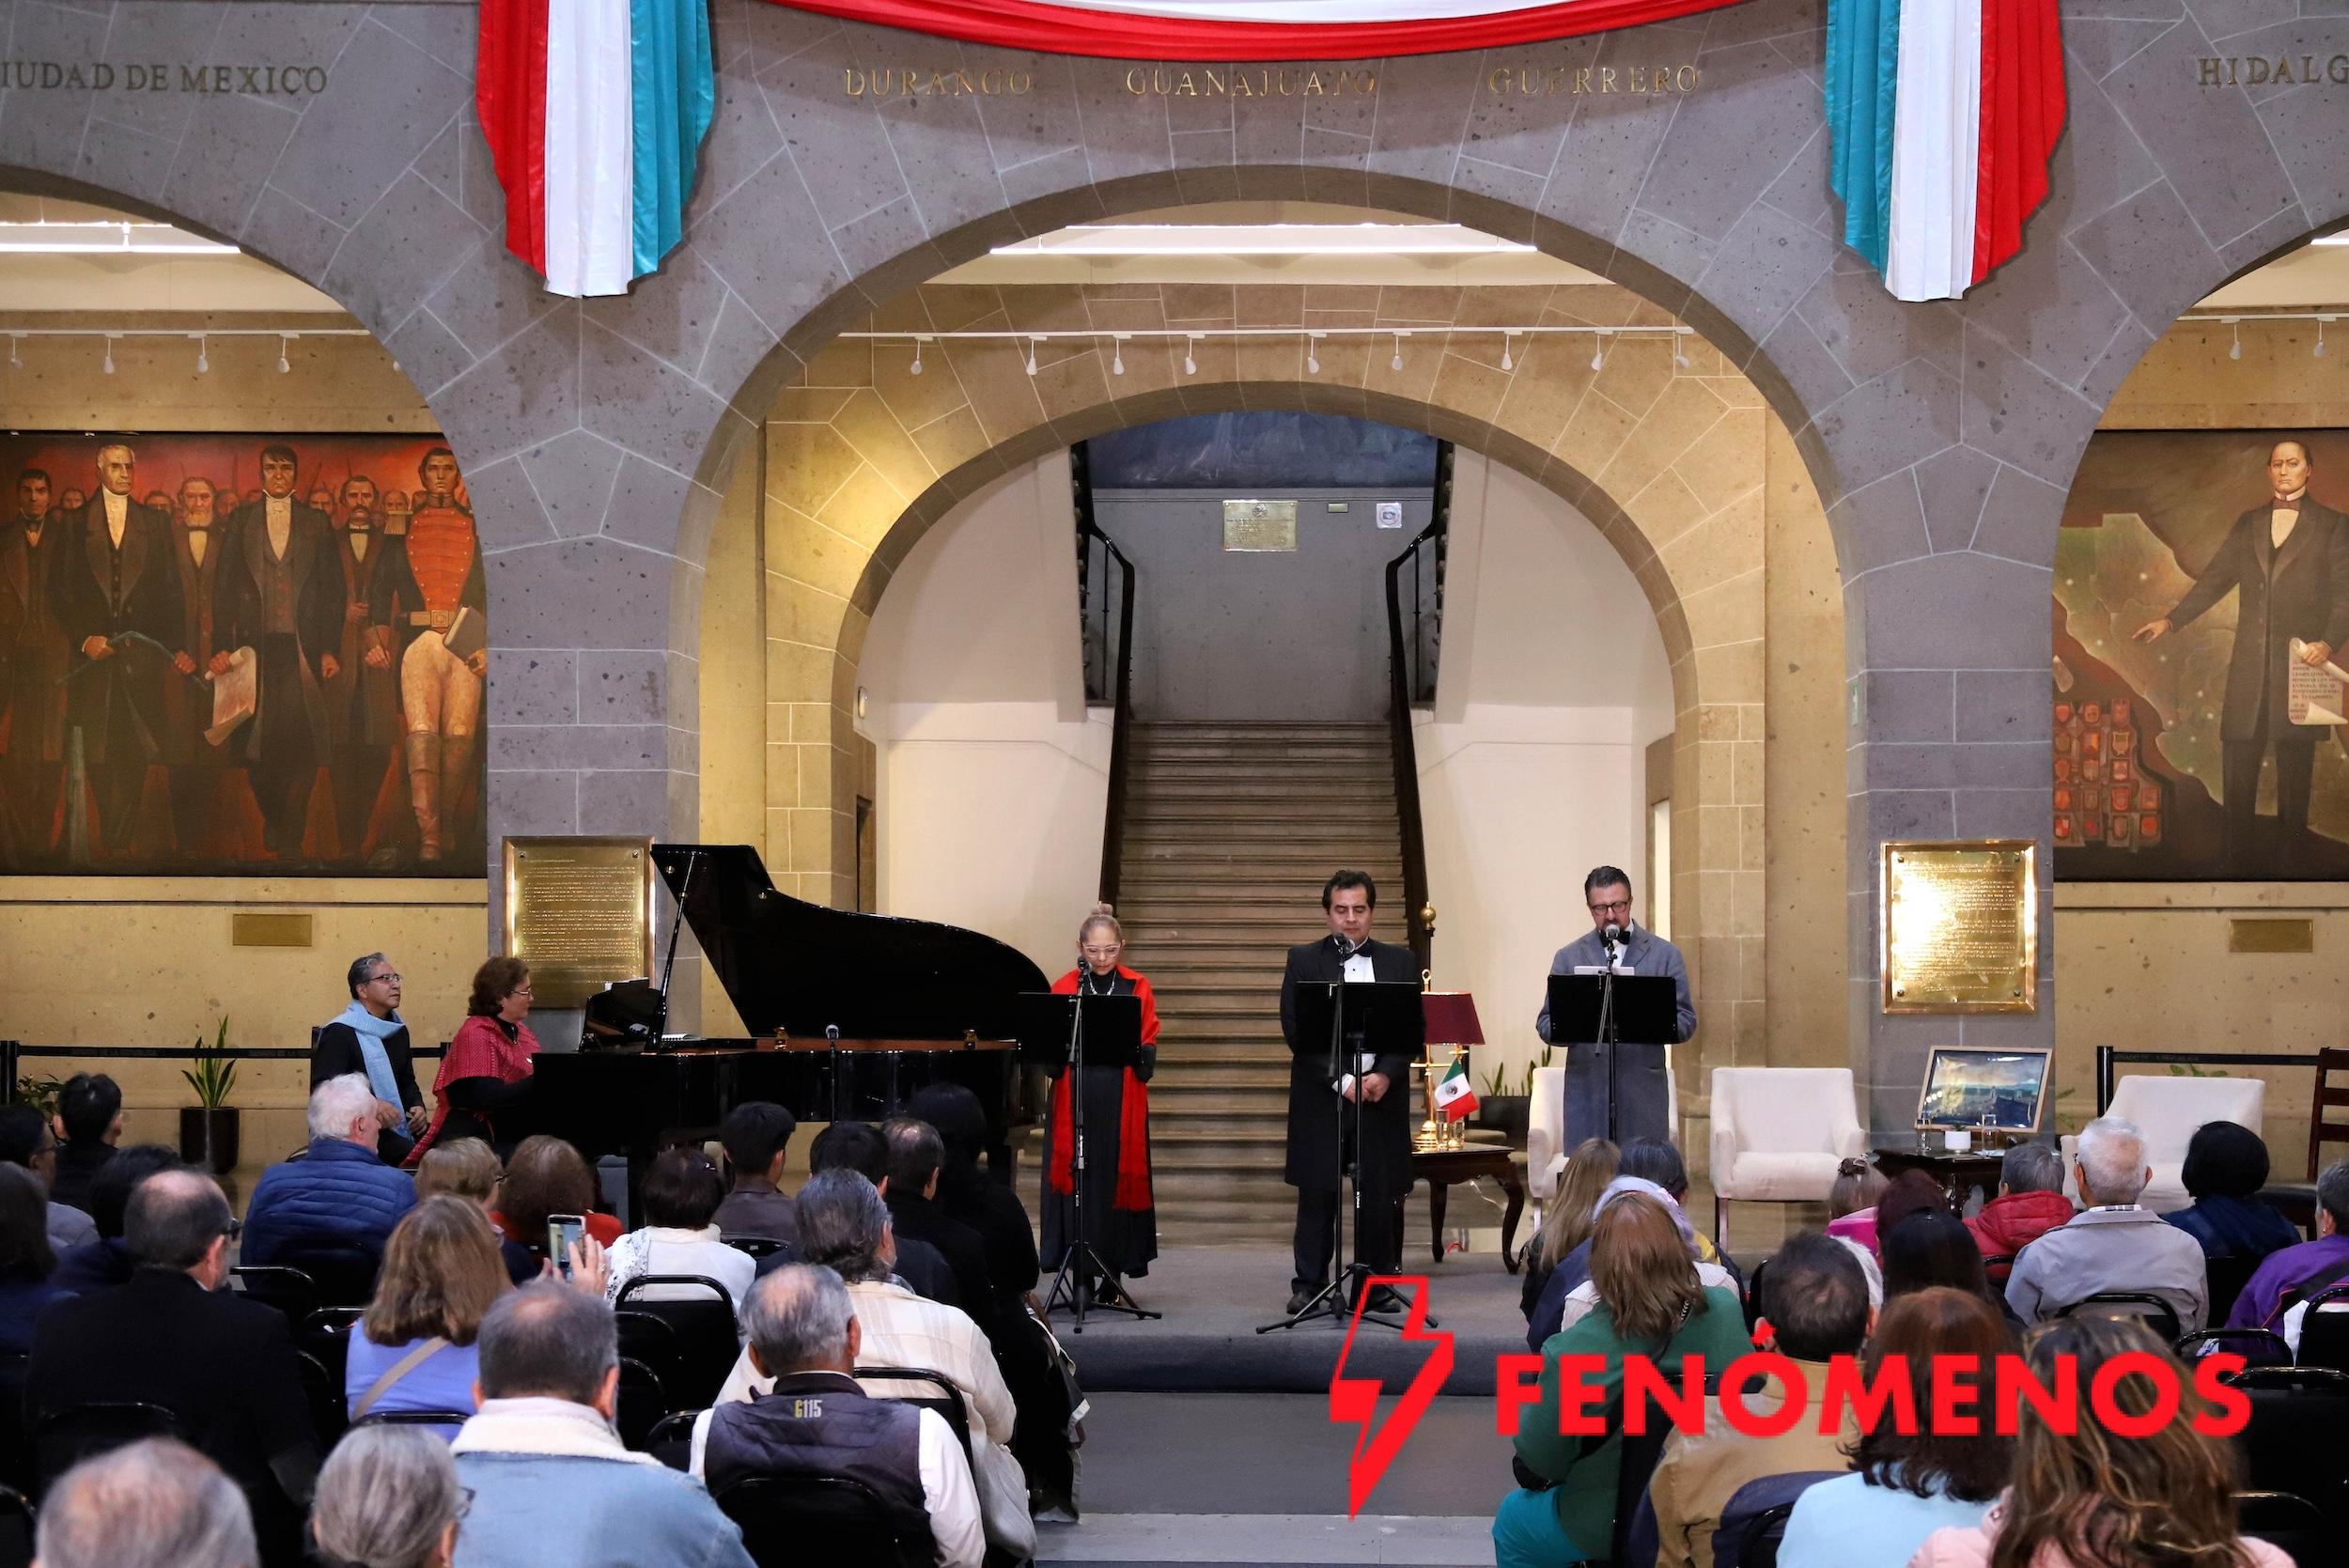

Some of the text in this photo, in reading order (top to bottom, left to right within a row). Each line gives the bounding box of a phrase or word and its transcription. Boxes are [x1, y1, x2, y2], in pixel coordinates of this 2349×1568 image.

[125, 64, 169, 91] DE
[180, 66, 327, 94] MEXICO
[846, 69, 1032, 97] DURANGO
[1126, 68, 1376, 97] GUANAJUATO
[1488, 65, 1700, 95] GUERRERO
